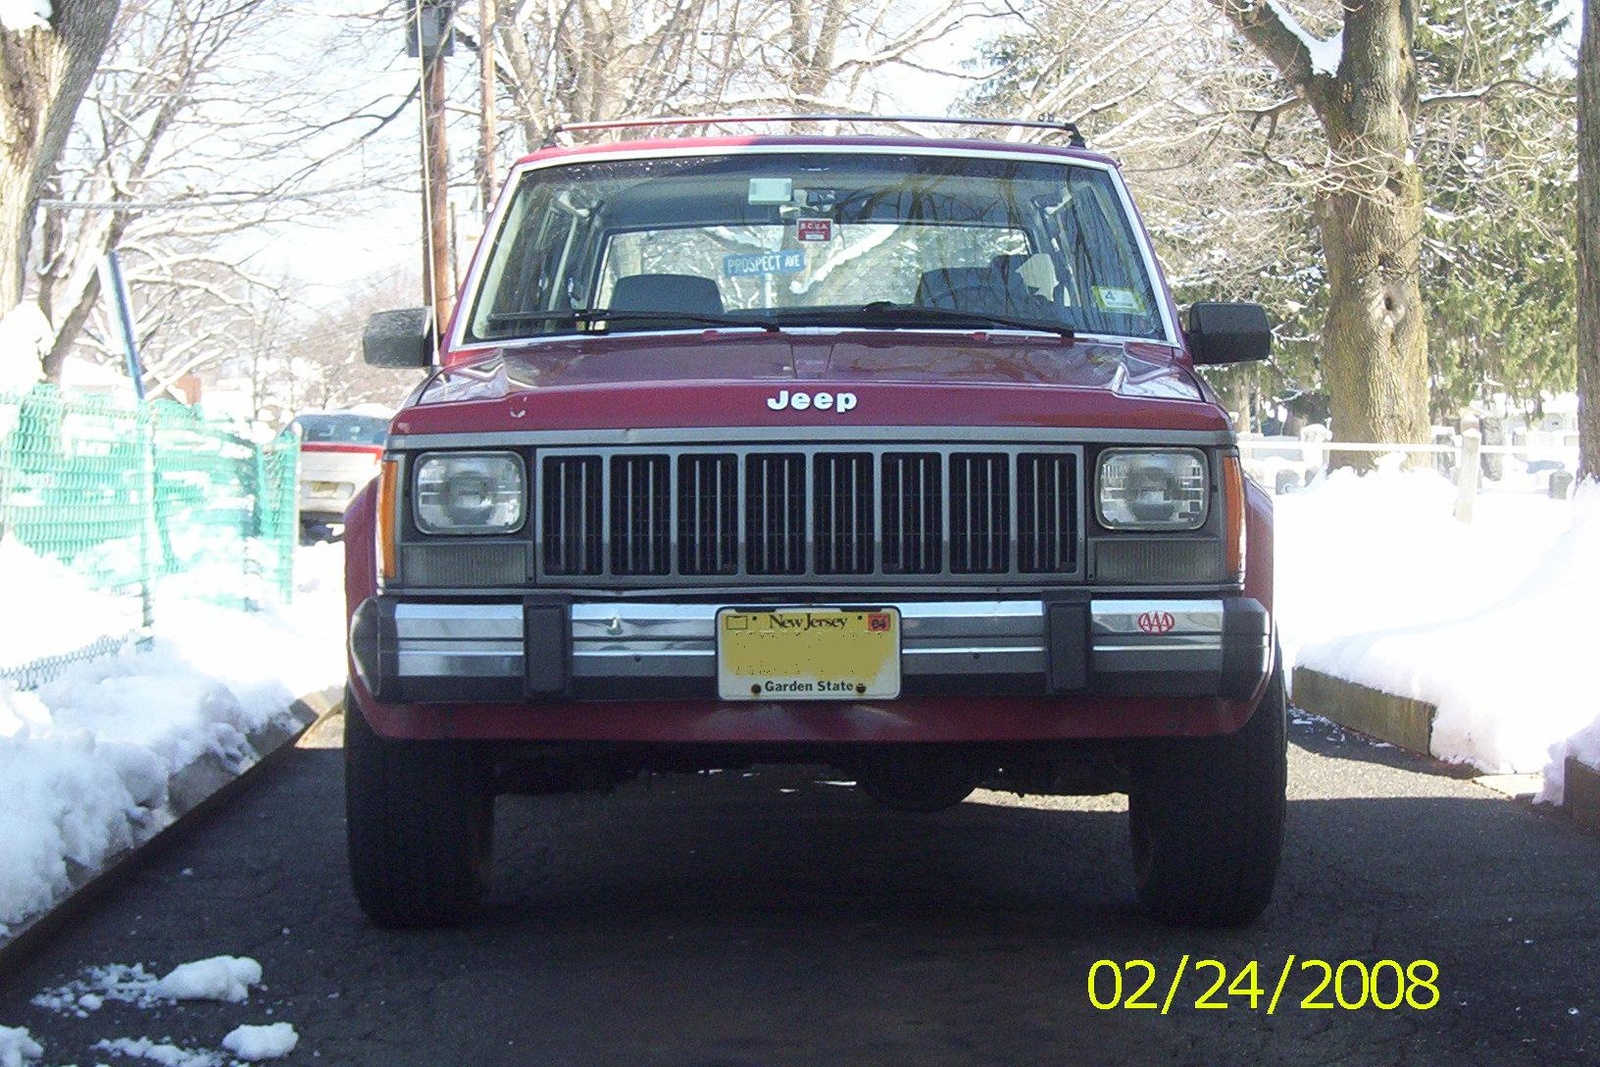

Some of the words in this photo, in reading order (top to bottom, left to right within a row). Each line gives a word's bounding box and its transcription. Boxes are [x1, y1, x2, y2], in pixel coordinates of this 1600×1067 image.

[727, 255, 782, 274] PROSPECT
[784, 254, 801, 267] AVE
[766, 392, 858, 413] Jeep
[769, 613, 803, 629] New
[804, 613, 848, 631] Jersey
[1139, 611, 1173, 636] AAA
[764, 681, 813, 692] Garden
[817, 681, 854, 692] State
